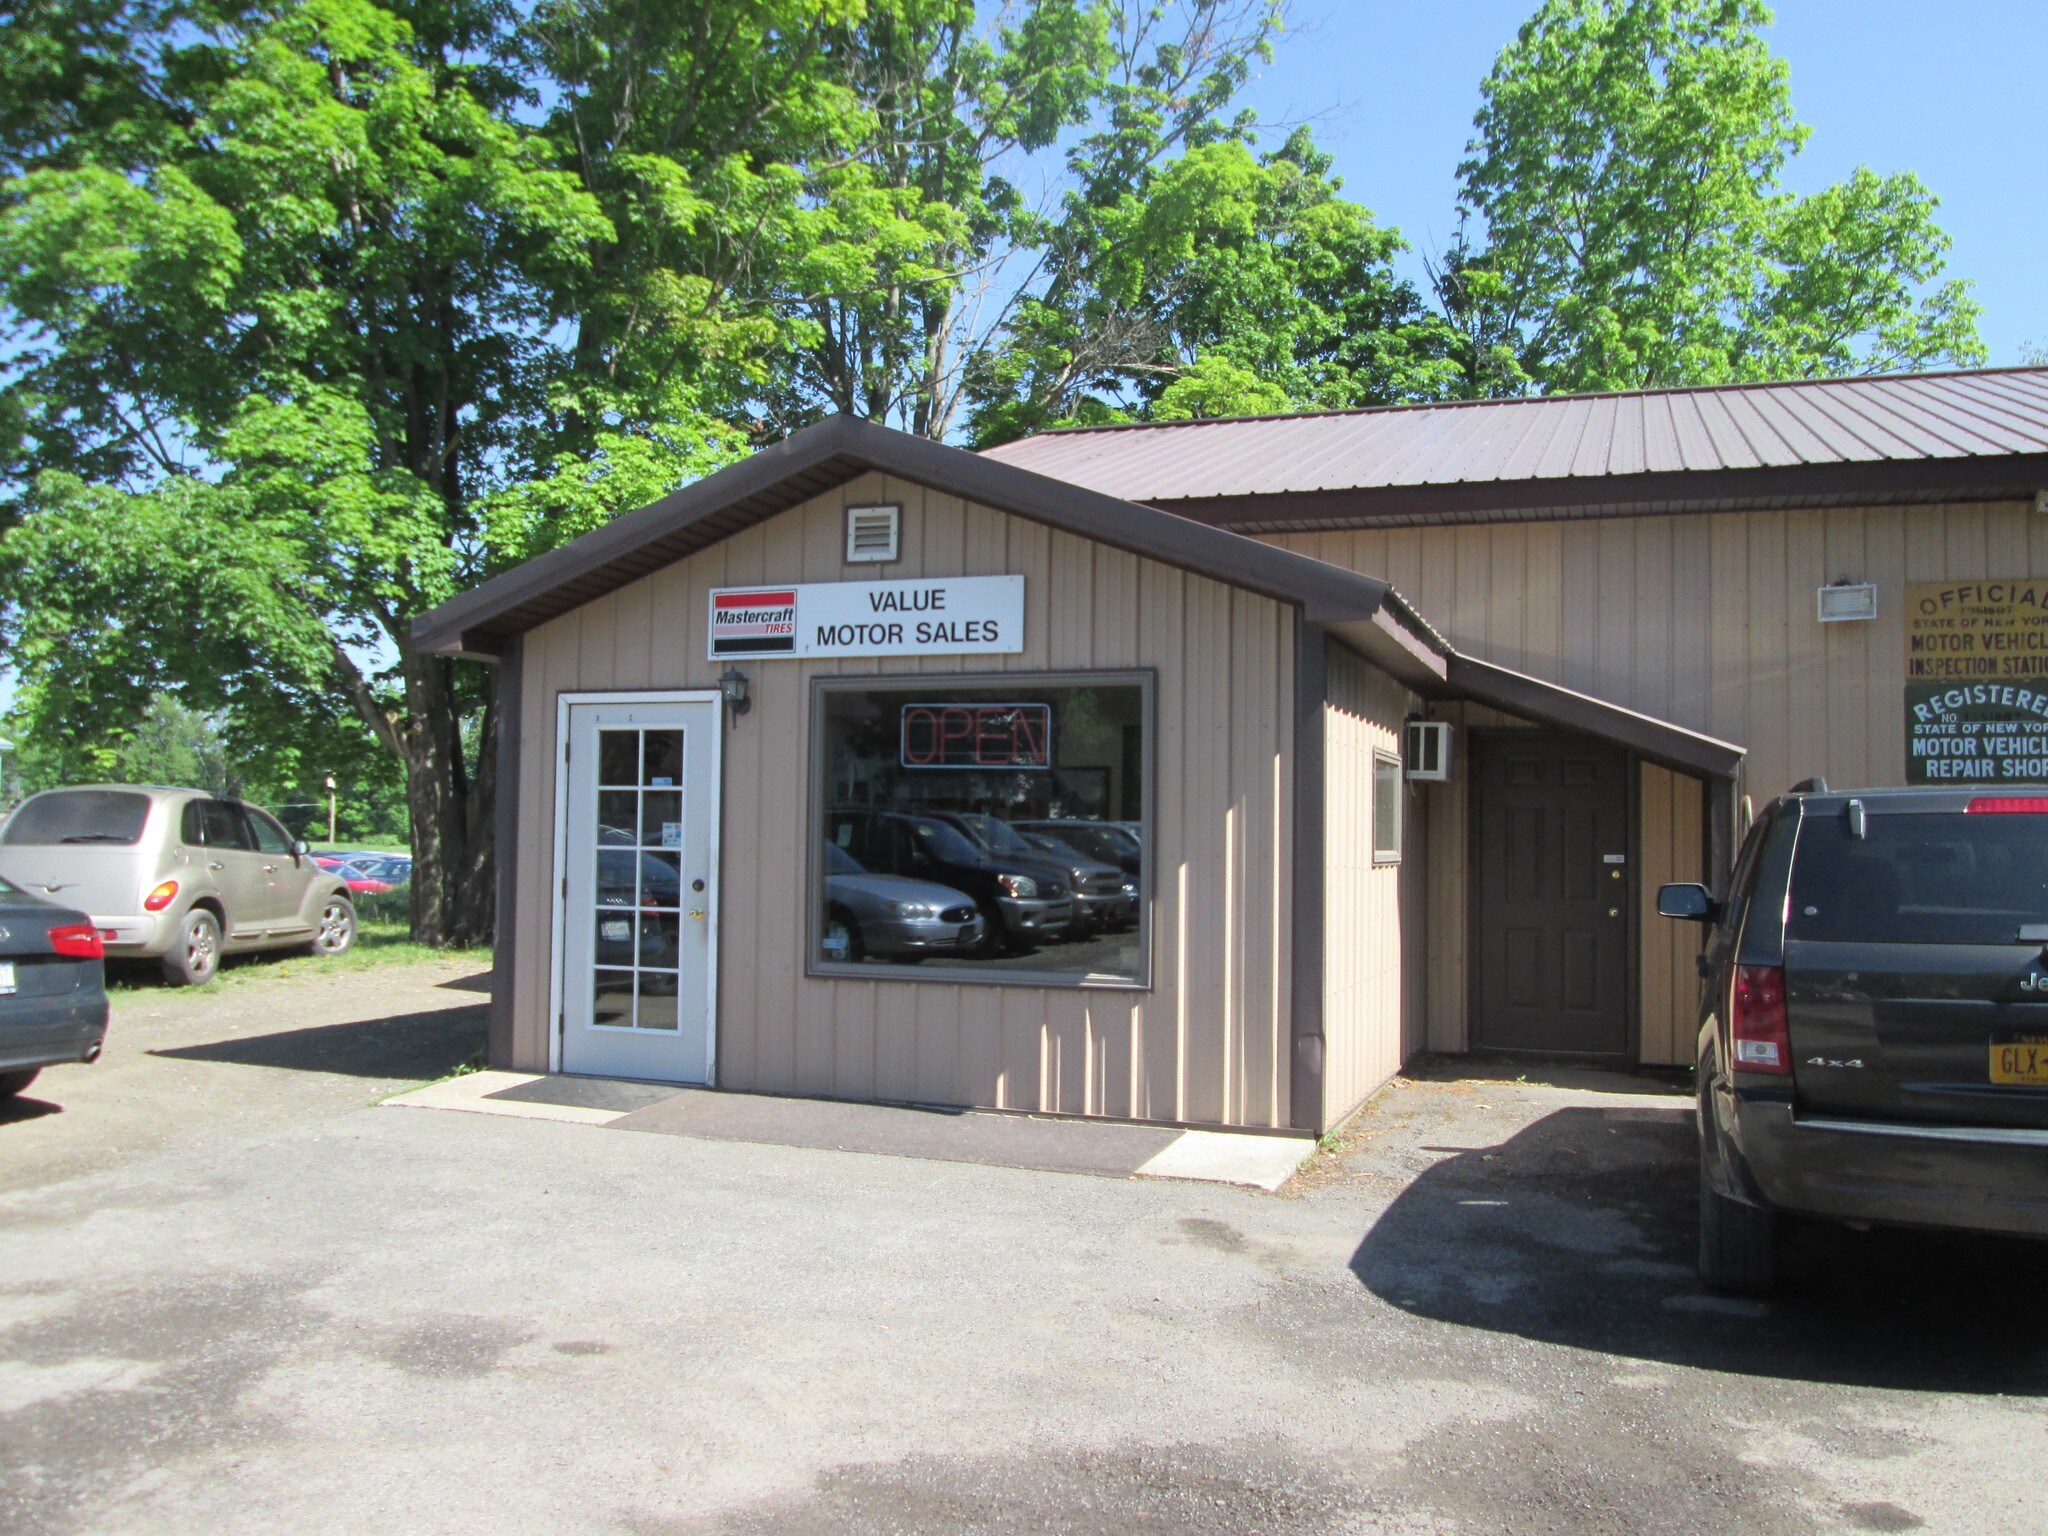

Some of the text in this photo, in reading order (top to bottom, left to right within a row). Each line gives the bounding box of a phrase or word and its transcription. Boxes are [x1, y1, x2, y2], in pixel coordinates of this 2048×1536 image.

[869, 588, 946, 612] VALUE
[715, 607, 794, 625] Mastercraft
[1912, 617, 1955, 629] STATE
[1960, 618, 1979, 628] OF
[1984, 617, 2016, 628] NEW
[764, 622, 793, 635] TIRES
[817, 619, 999, 647] MOTOR SALES
[1911, 633, 1974, 651] MOTOR
[1909, 656, 1998, 676] INSPECTION
[905, 707, 1047, 764] OPEN
[1914, 724, 1957, 734] STATE
[1962, 723, 1981, 734] OF
[1985, 723, 2017, 733] NEW
[1912, 737, 1977, 756] MOTOR
[1926, 759, 1994, 777] REPAIR
[1807, 1057, 1864, 1068] 4x4
